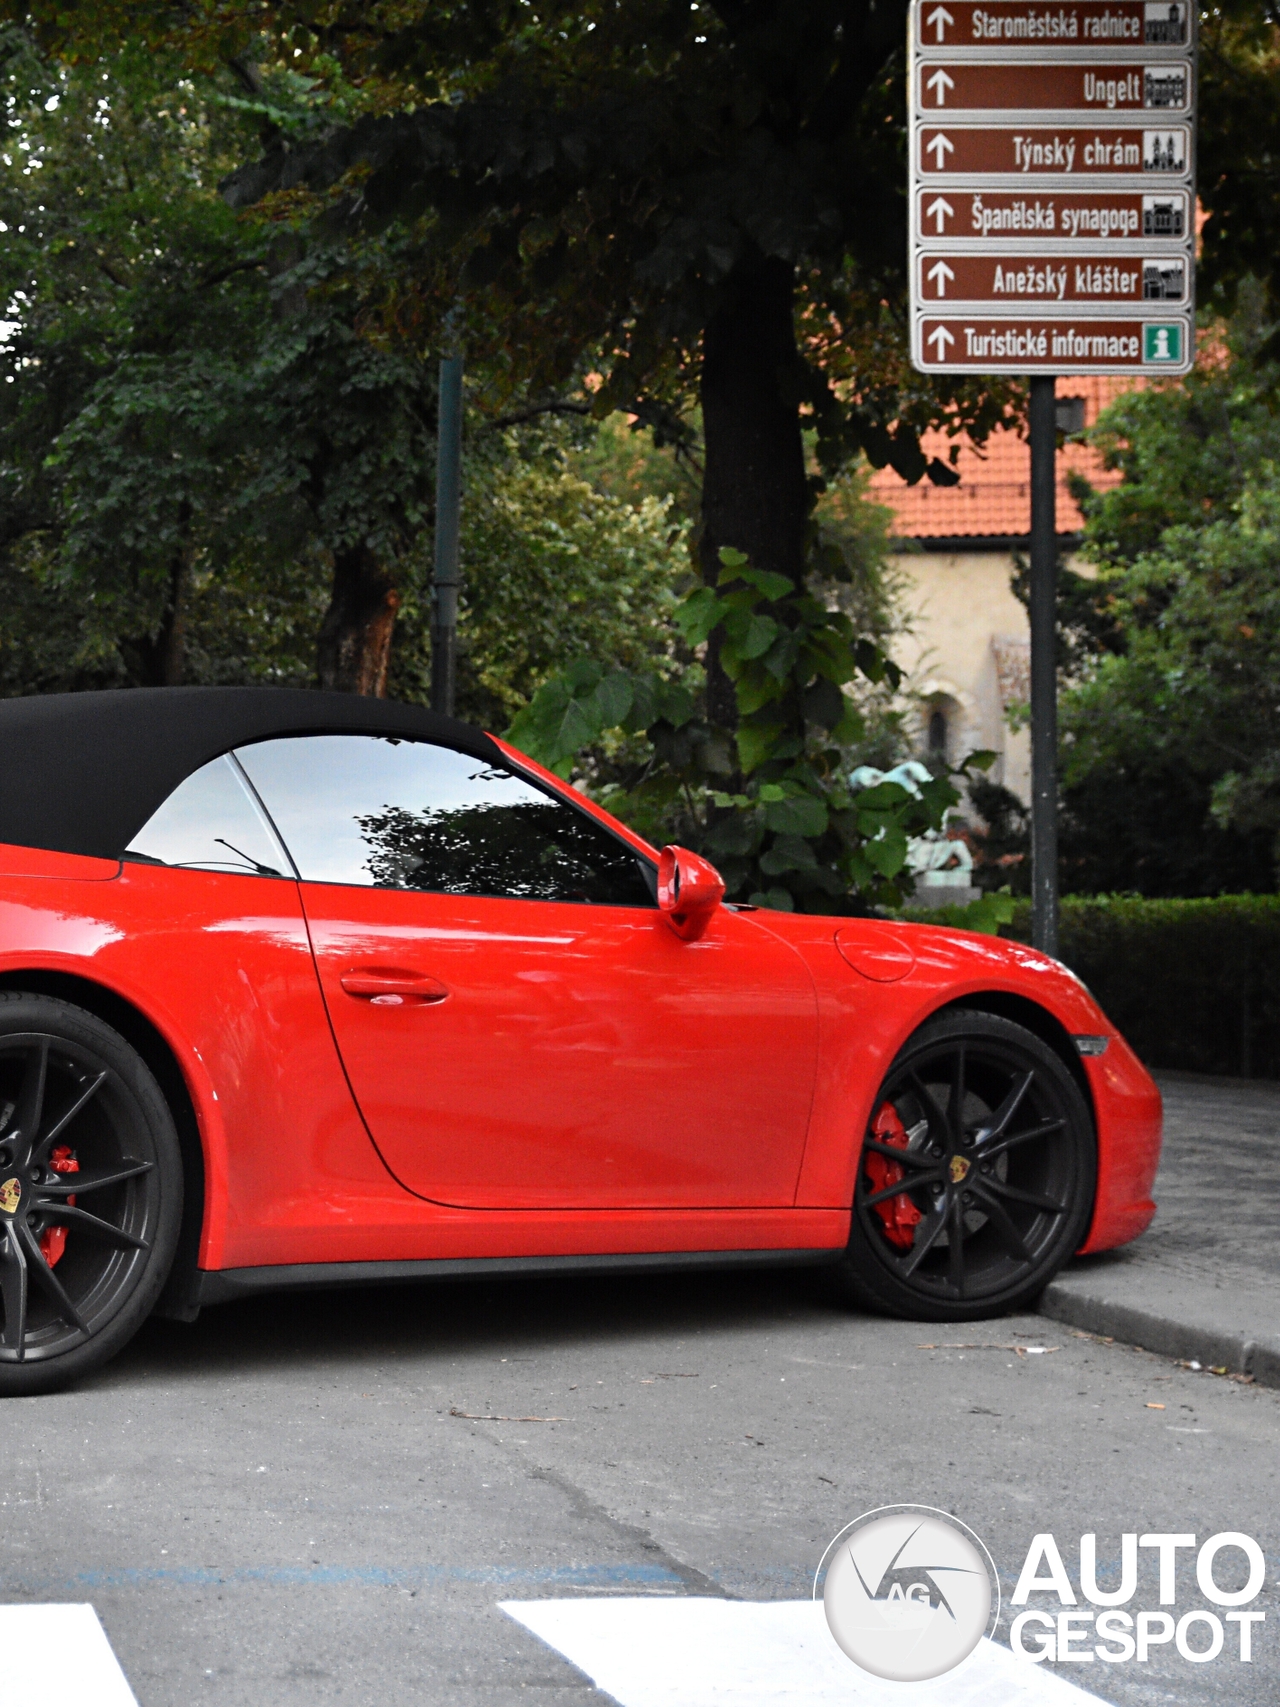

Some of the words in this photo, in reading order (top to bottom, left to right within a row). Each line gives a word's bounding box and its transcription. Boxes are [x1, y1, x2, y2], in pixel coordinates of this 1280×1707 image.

[972, 9, 1078, 38] Staroměstská
[1084, 10, 1140, 38] radnice
[1084, 73, 1140, 108] Ungelt
[1013, 137, 1076, 172] Týnský
[1084, 137, 1140, 165] chrám
[972, 195, 1056, 236] Španělská
[1061, 208, 1138, 237] synagoga
[993, 265, 1067, 299] Anežský
[1075, 265, 1138, 293] klášter
[964, 328, 1048, 358] Turistické
[1052, 328, 1139, 357] informace
